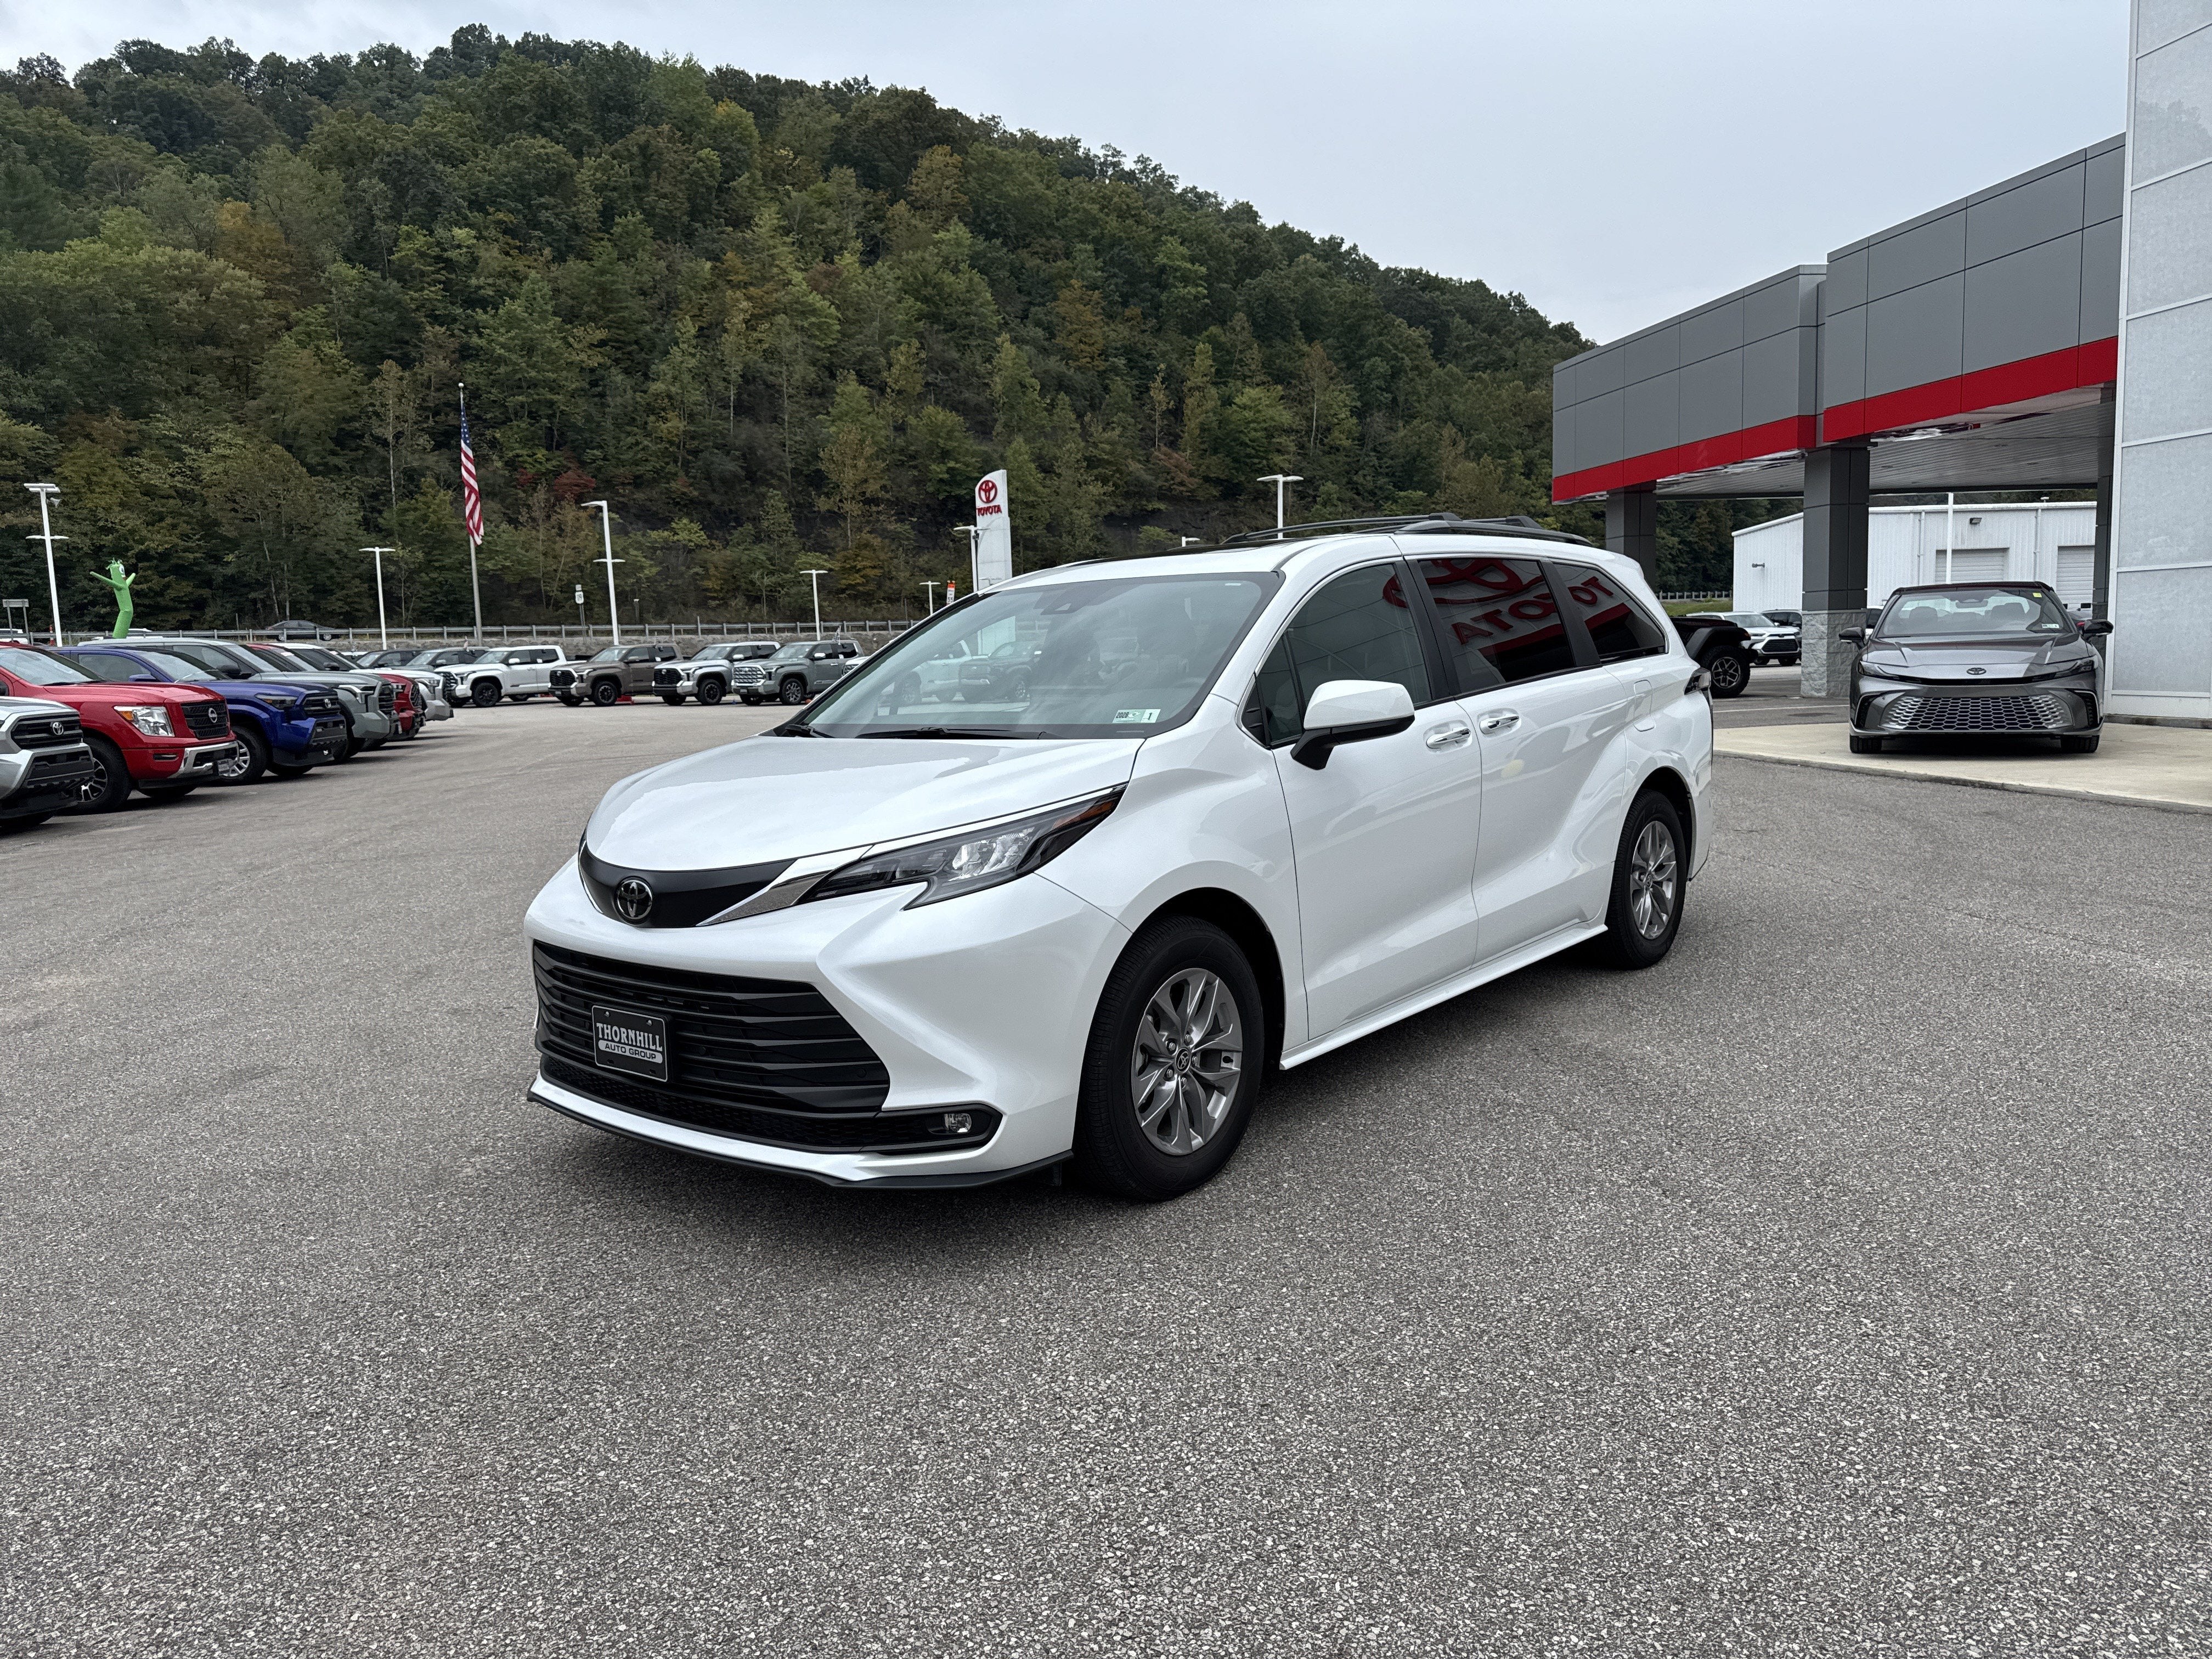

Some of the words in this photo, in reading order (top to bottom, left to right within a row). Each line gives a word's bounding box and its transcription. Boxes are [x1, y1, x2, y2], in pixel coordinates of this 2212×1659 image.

[977, 505, 1002, 516] TOYOTA
[1148, 712, 1153, 721] 1
[596, 1023, 663, 1052] THORNHILL
[605, 1043, 626, 1053] AUTO
[629, 1048, 656, 1060] GROUP
